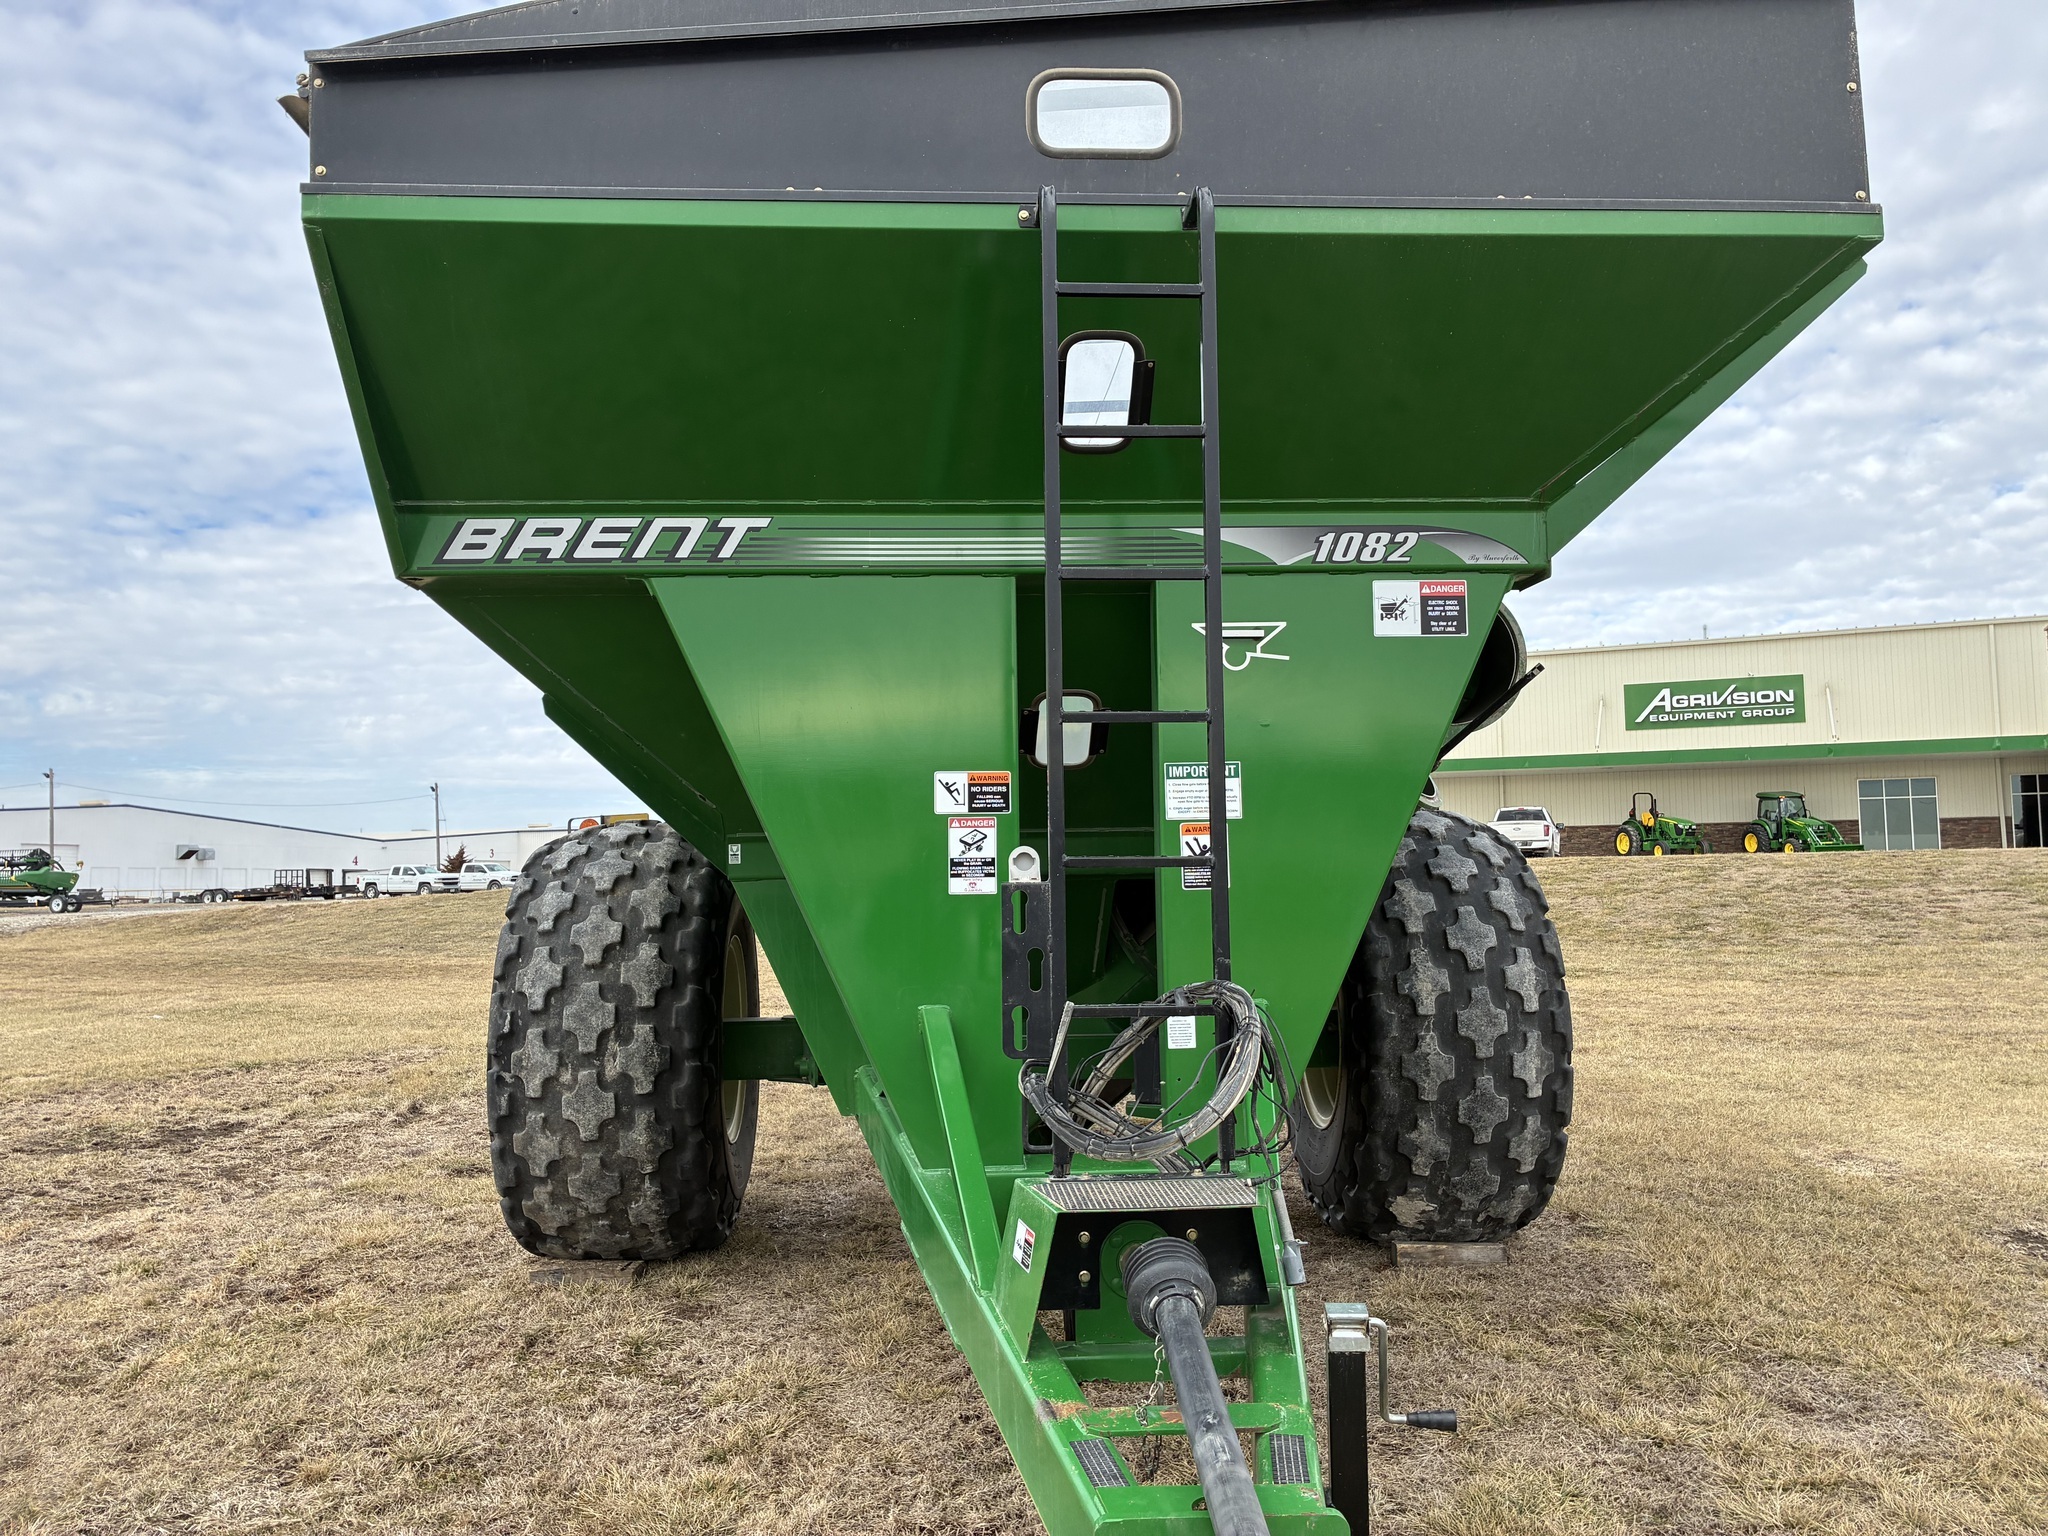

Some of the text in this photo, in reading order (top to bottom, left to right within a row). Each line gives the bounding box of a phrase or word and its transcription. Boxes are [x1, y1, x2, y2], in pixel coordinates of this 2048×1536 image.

[435, 516, 773, 563] BRENT
[1313, 531, 1421, 563] 1082
[1468, 554, 1480, 563] By
[1649, 708, 1796, 722] EQUIPMENT GROUP
[1168, 765, 1237, 778] IMPORT
[489, 849, 495, 858] 3
[352, 855, 358, 866] 4
